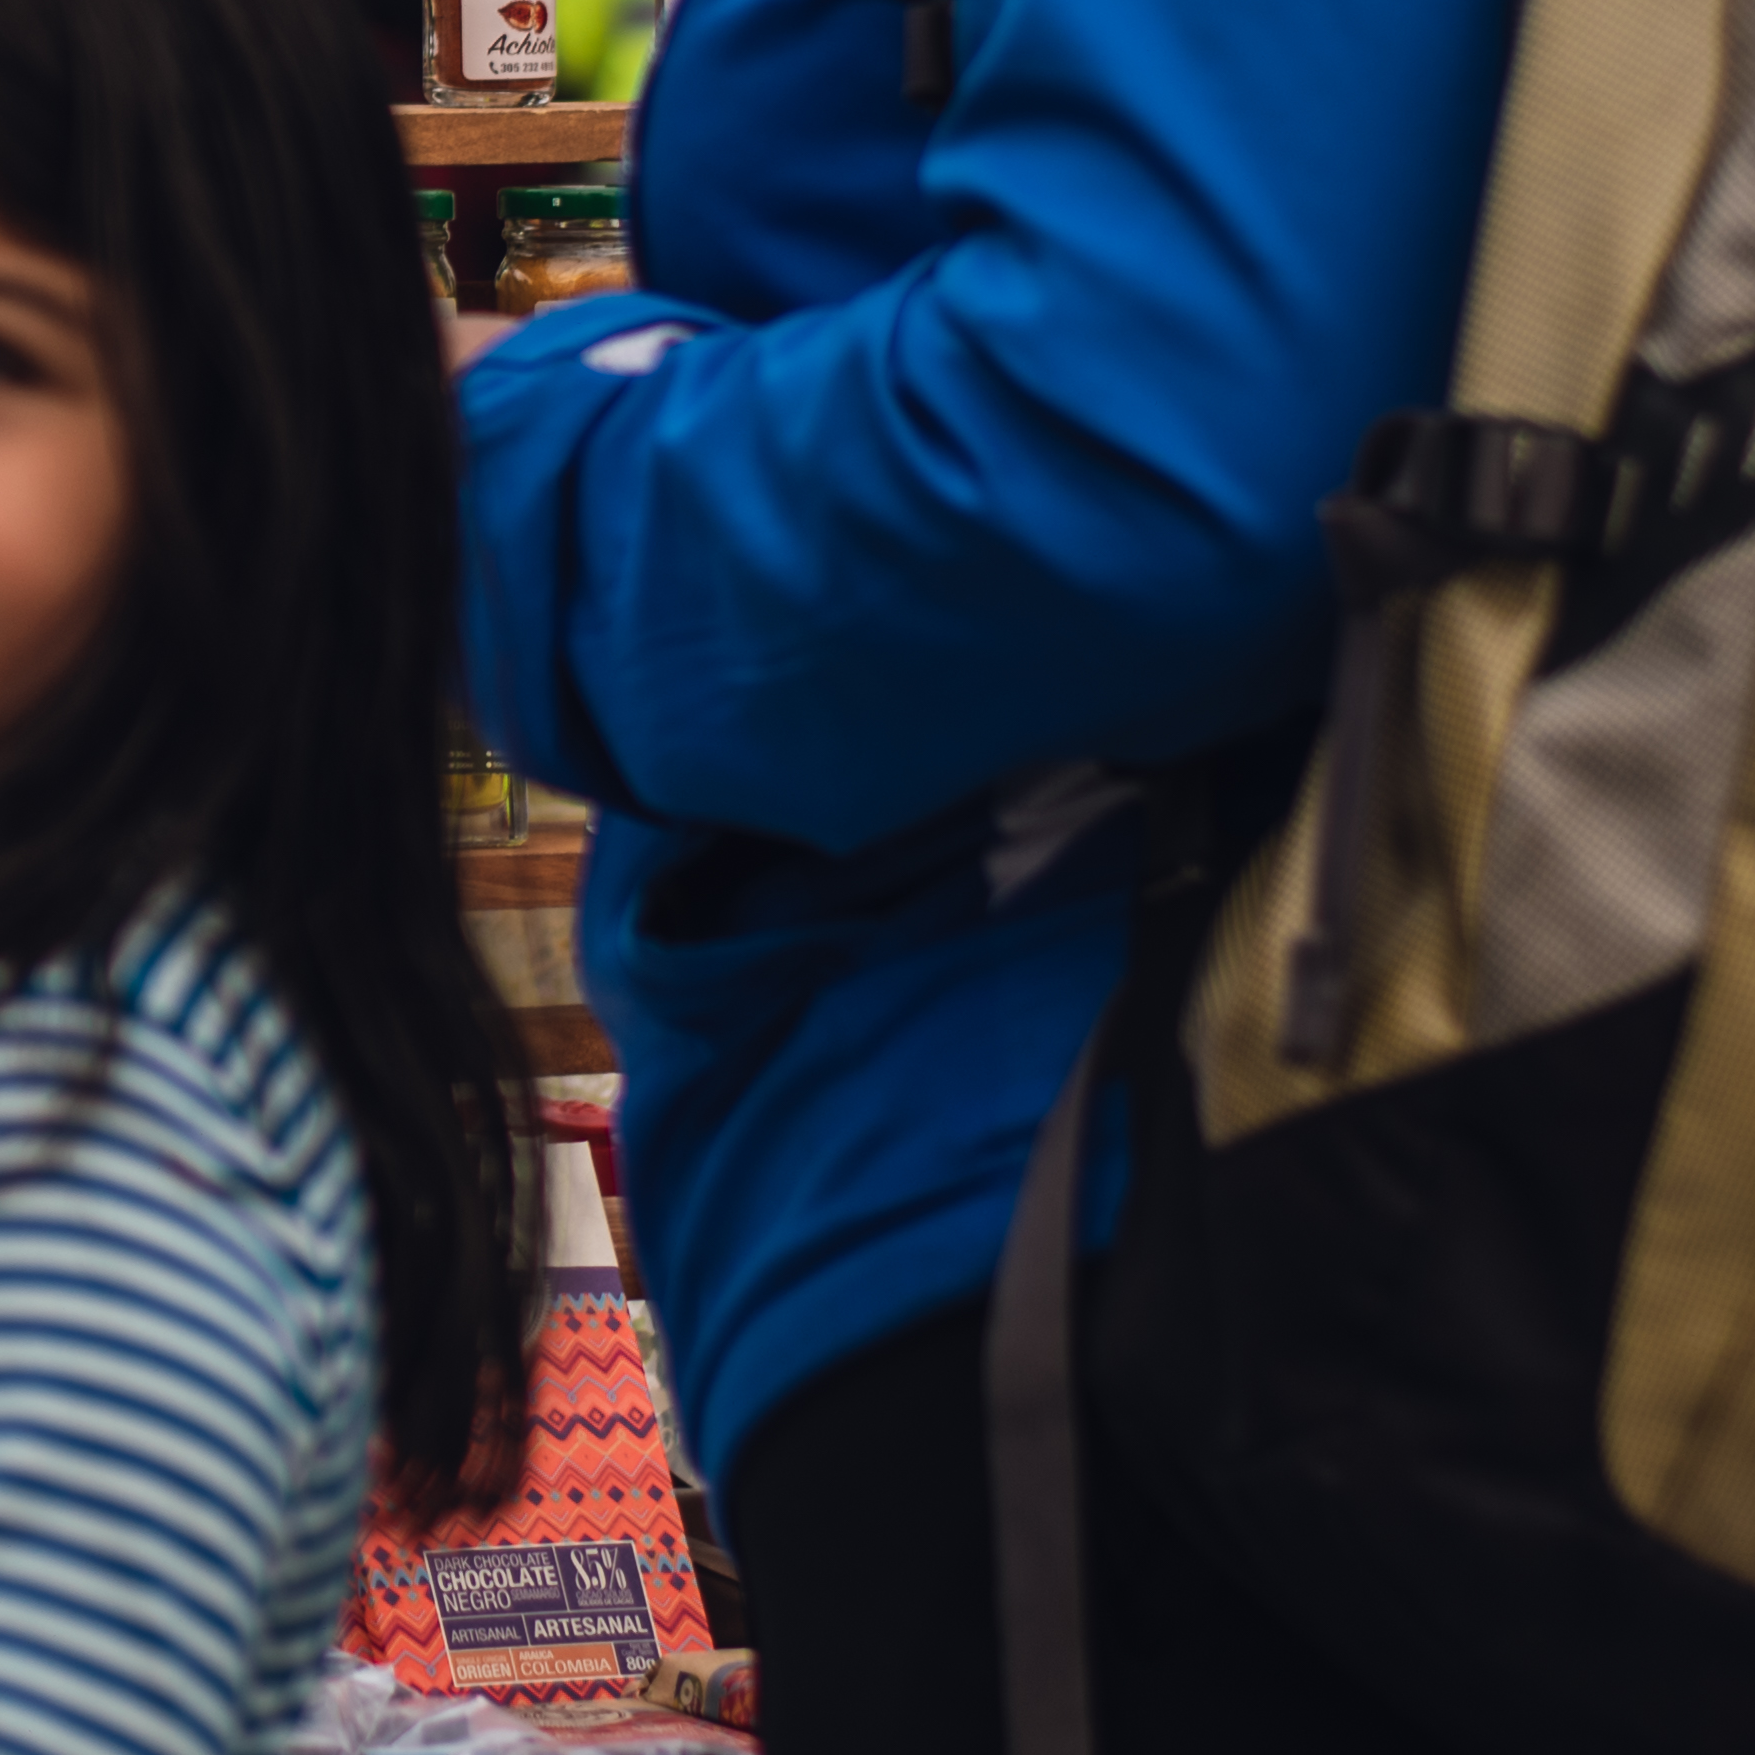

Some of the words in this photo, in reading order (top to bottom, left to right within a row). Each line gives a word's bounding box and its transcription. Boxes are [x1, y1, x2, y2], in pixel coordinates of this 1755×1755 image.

[434, 1557, 470, 1572] DARK
[473, 1551, 551, 1568] CHOCOLATE
[570, 1547, 627, 1591] 85%
[437, 1565, 558, 1592] CHOCOLATE
[442, 1589, 512, 1613] NEGRO
[451, 1626, 522, 1644] ARTISANAL
[534, 1614, 648, 1639] ARTESANAL
[519, 1649, 554, 1661] ARAUCA
[456, 1662, 512, 1681] ORIGEN
[520, 1657, 613, 1677] COLOMBIA
